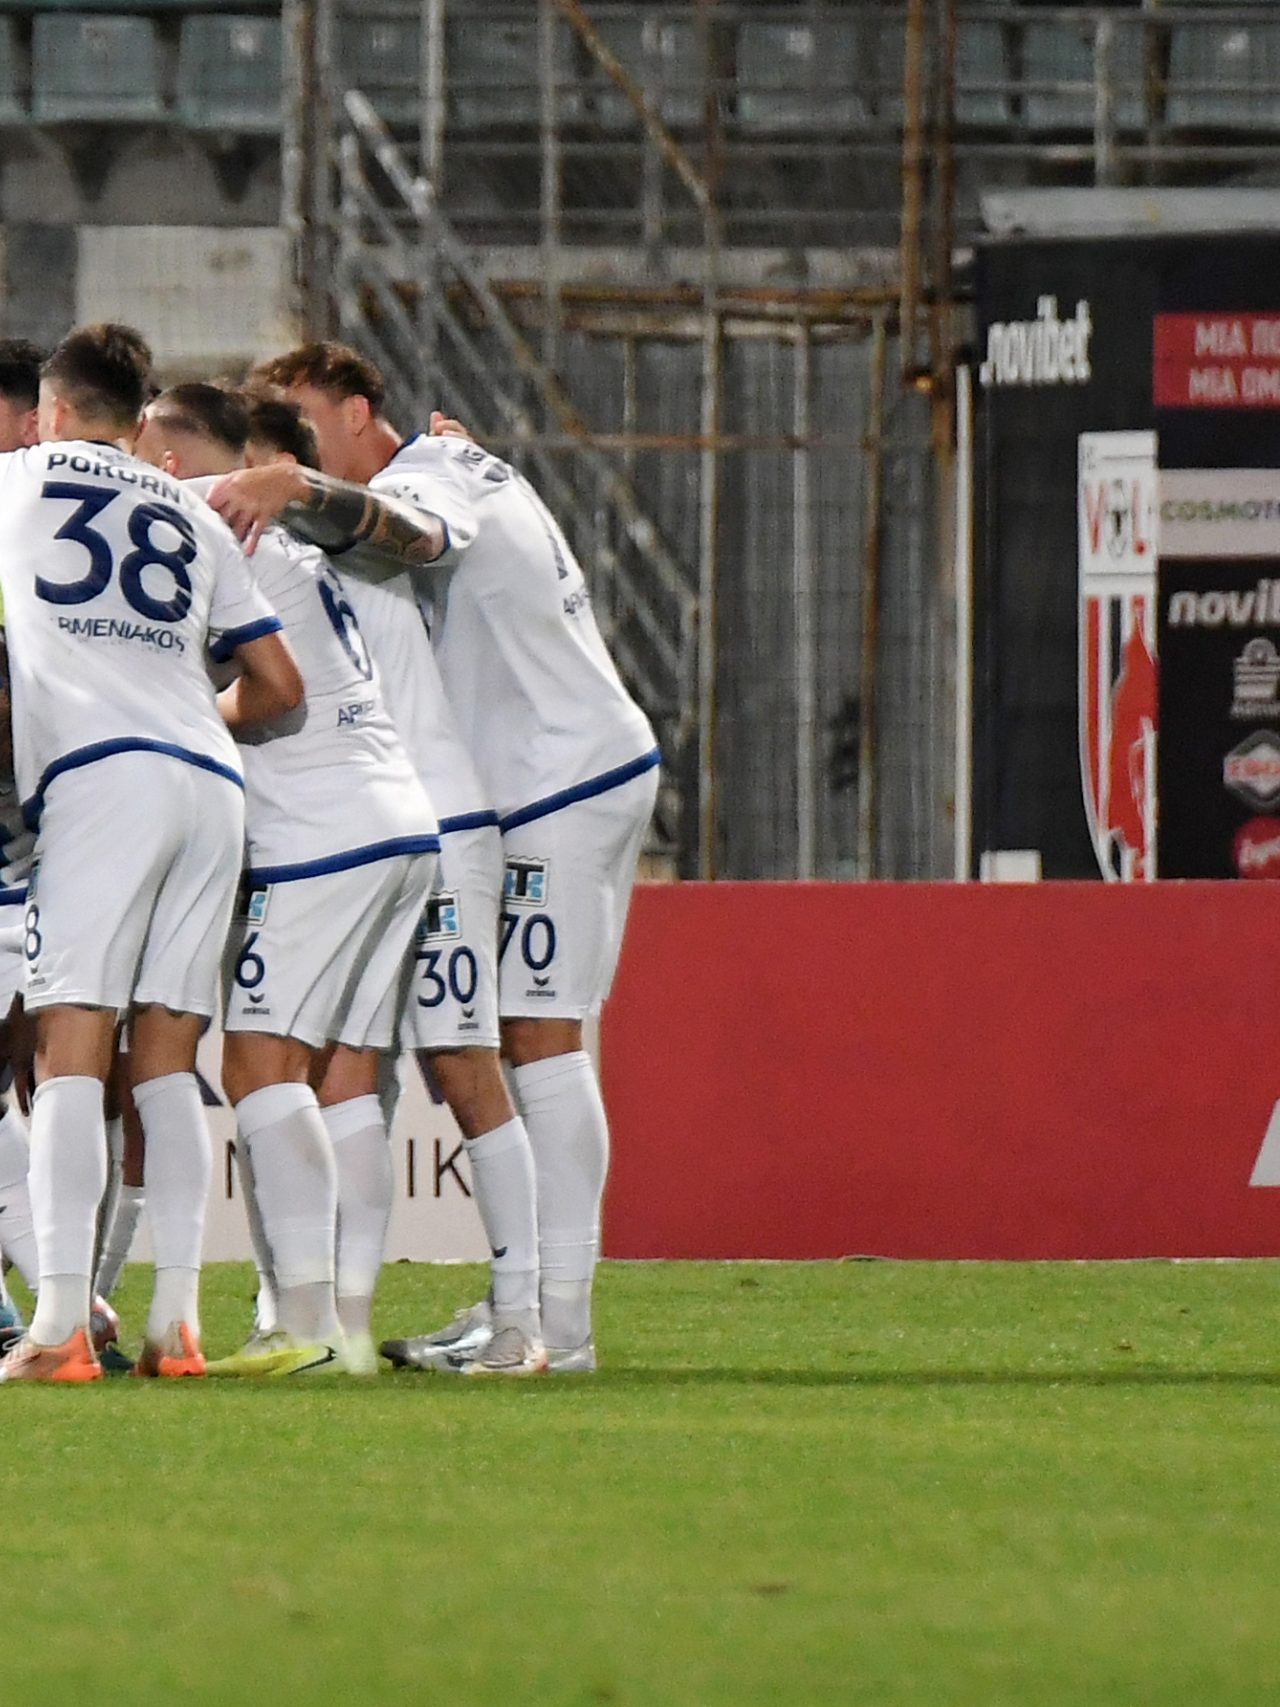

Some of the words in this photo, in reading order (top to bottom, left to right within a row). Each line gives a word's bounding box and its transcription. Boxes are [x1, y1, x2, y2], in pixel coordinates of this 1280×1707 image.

[1160, 500, 1280, 522] COSMOT
[35, 480, 198, 623] 38
[52, 616, 185, 652] RMENIAKOS
[234, 931, 265, 989] 6
[500, 913, 556, 971] 70
[415, 945, 478, 1008] 30
